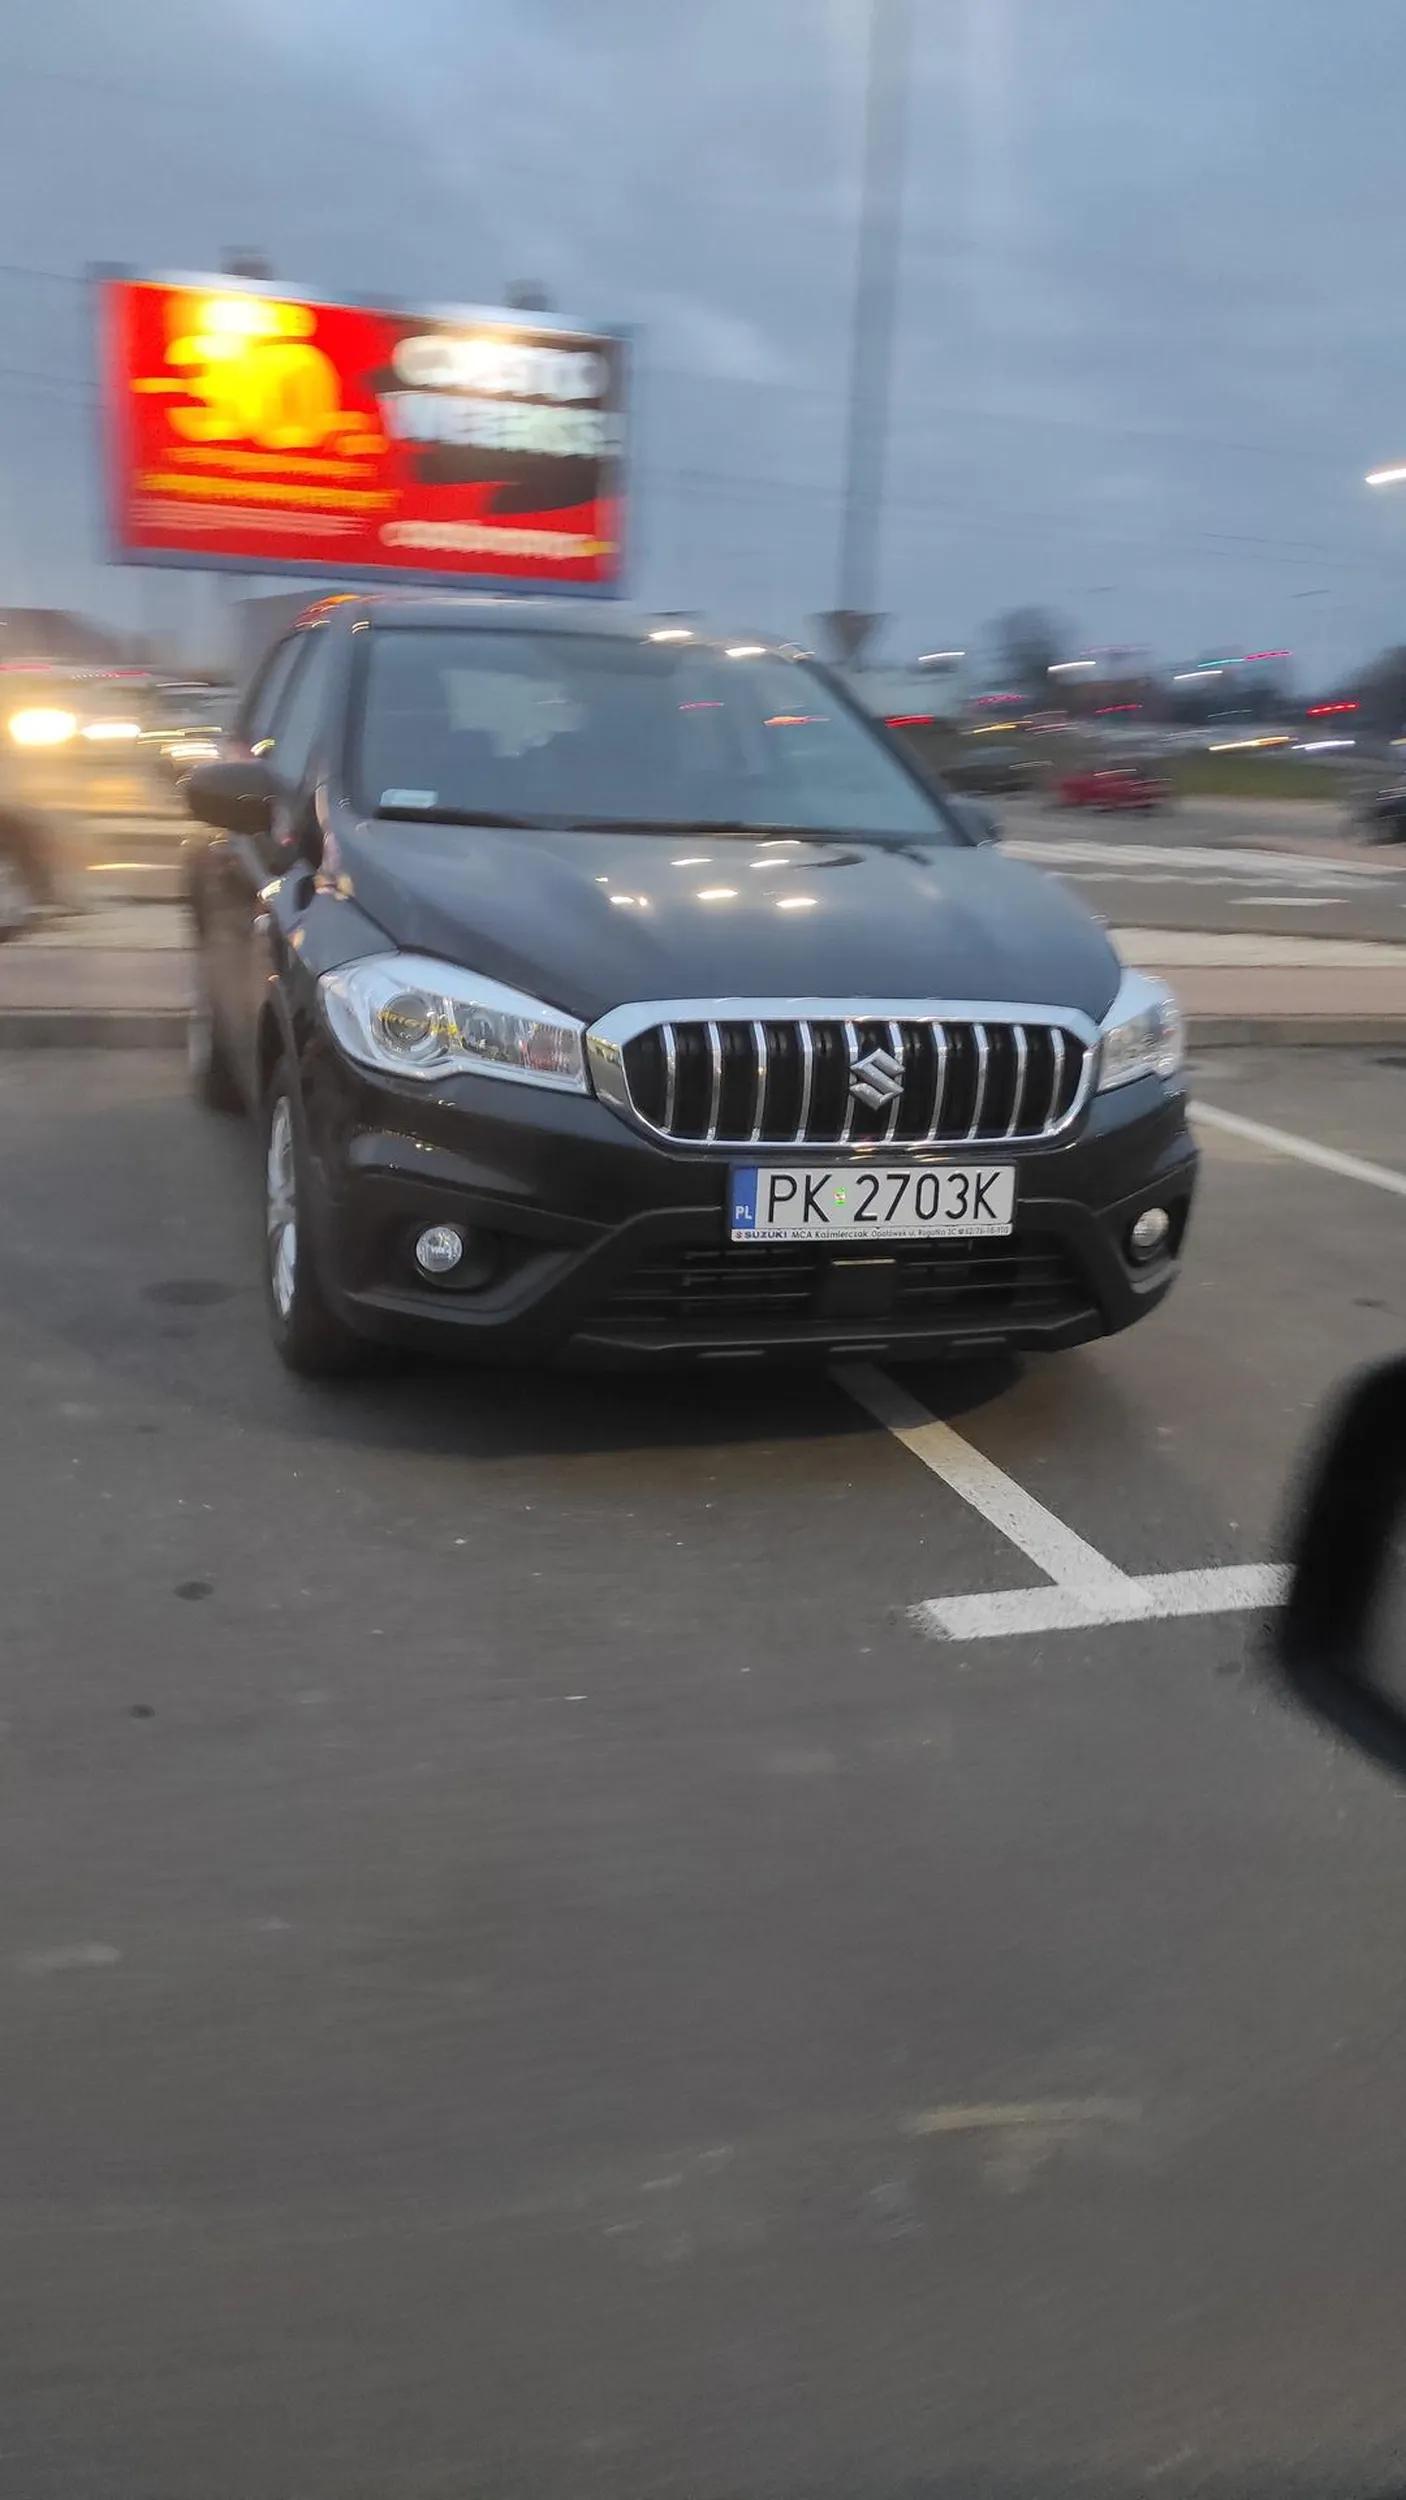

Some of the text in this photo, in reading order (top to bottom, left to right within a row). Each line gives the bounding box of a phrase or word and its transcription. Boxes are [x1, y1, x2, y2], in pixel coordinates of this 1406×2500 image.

[768, 1171, 1001, 1223] PK 2703K
[735, 1205, 752, 1220] PL
[744, 1231, 788, 1239] SUZUKI
[791, 1230, 812, 1239] MCA
